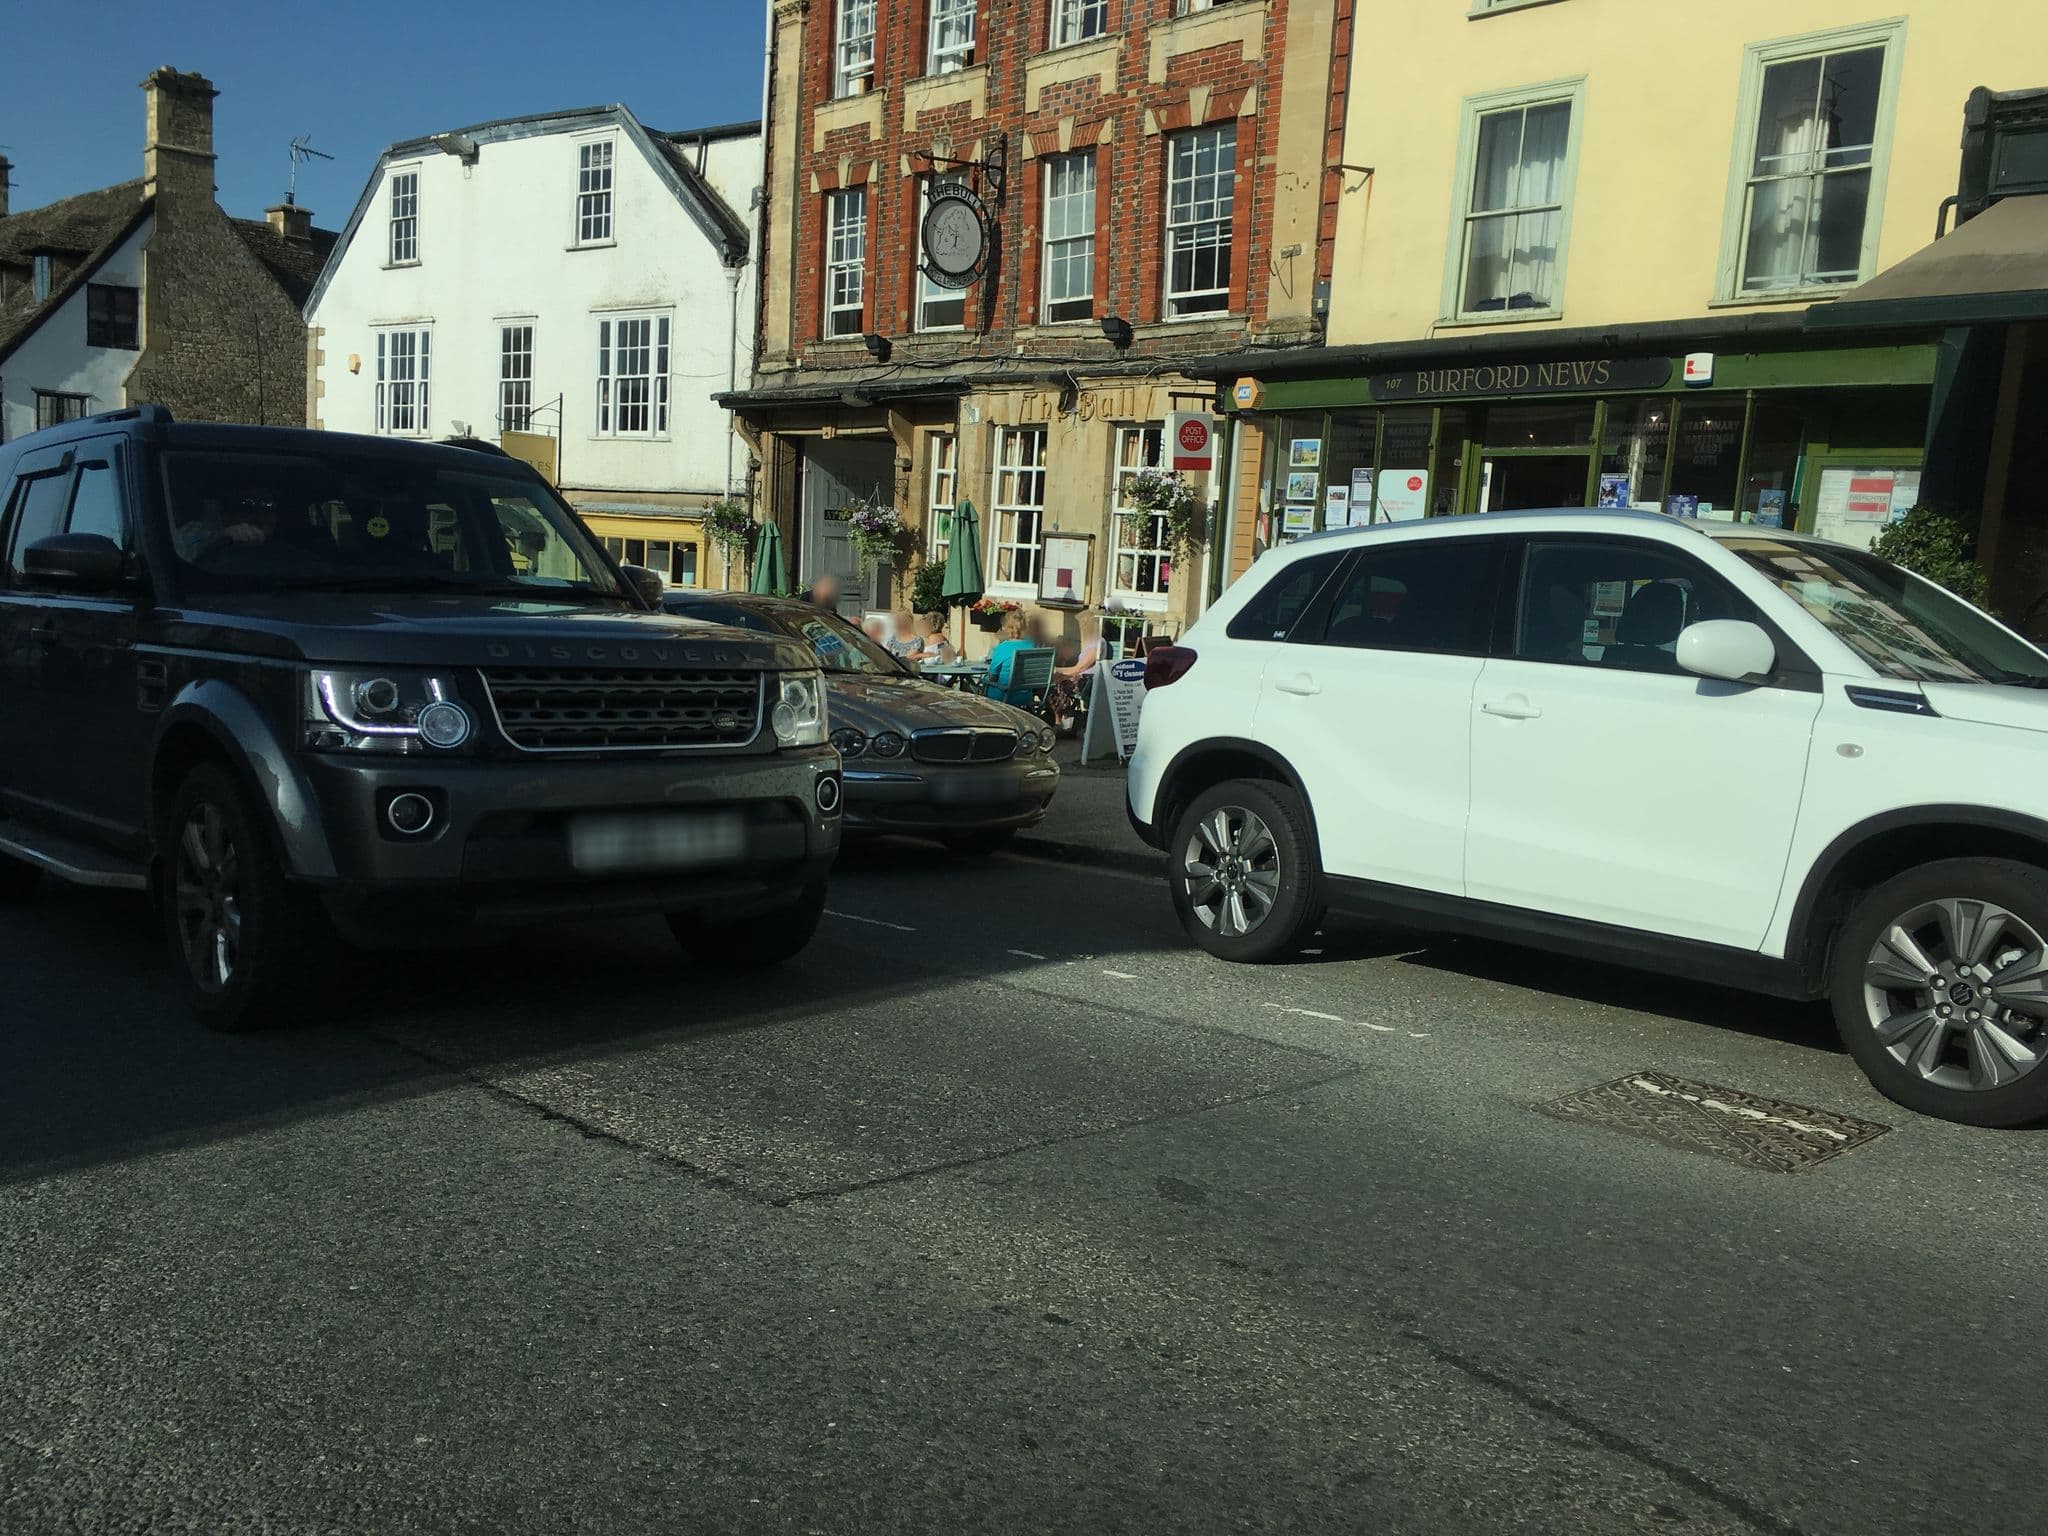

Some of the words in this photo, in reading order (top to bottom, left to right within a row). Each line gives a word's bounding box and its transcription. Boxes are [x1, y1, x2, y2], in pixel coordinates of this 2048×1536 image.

[929, 185, 951, 201] THE
[952, 185, 979, 208] BULL
[1385, 378, 1403, 390] 107
[1415, 365, 1530, 394] BURFORD
[1536, 359, 1612, 387] NEWS
[1080, 387, 1136, 422] Bull
[1182, 435, 1205, 444] OFFICE
[1185, 426, 1203, 435] POST
[487, 644, 754, 663] DISCOVERY
